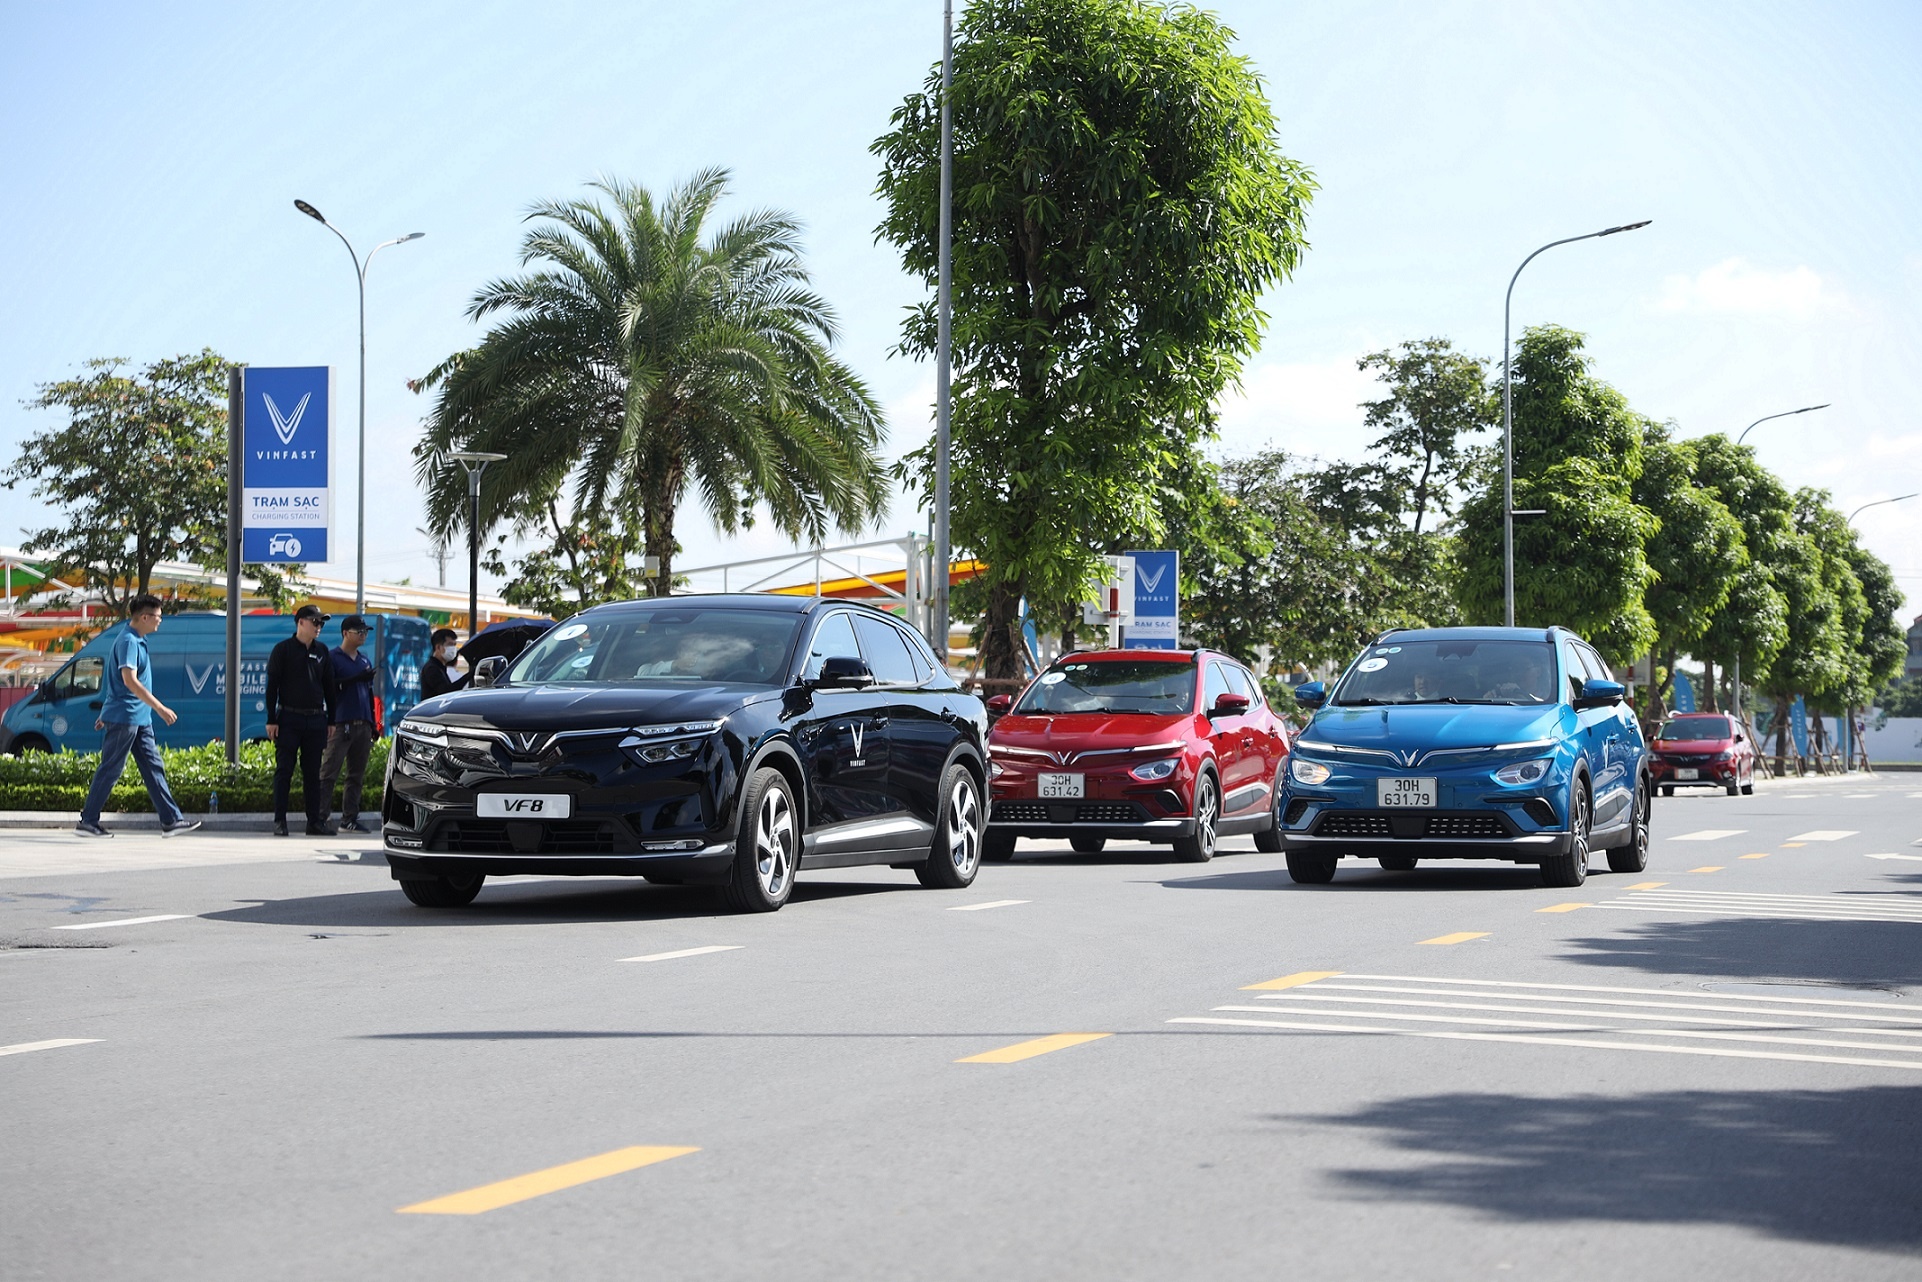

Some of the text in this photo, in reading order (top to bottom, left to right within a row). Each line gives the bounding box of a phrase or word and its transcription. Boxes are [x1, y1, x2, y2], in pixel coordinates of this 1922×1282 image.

[256, 450, 317, 460] VINFAST
[252, 496, 320, 510] TRẠM SẠC
[251, 513, 320, 521] CHARGING STATION
[217, 663, 268, 672] VFAST
[215, 674, 267, 685] MBILE
[1051, 775, 1071, 785] 30H
[1394, 779, 1420, 792] 30H
[1042, 786, 1080, 797] 631.42
[1384, 793, 1430, 806] 631.79
[503, 799, 544, 812] VF8
